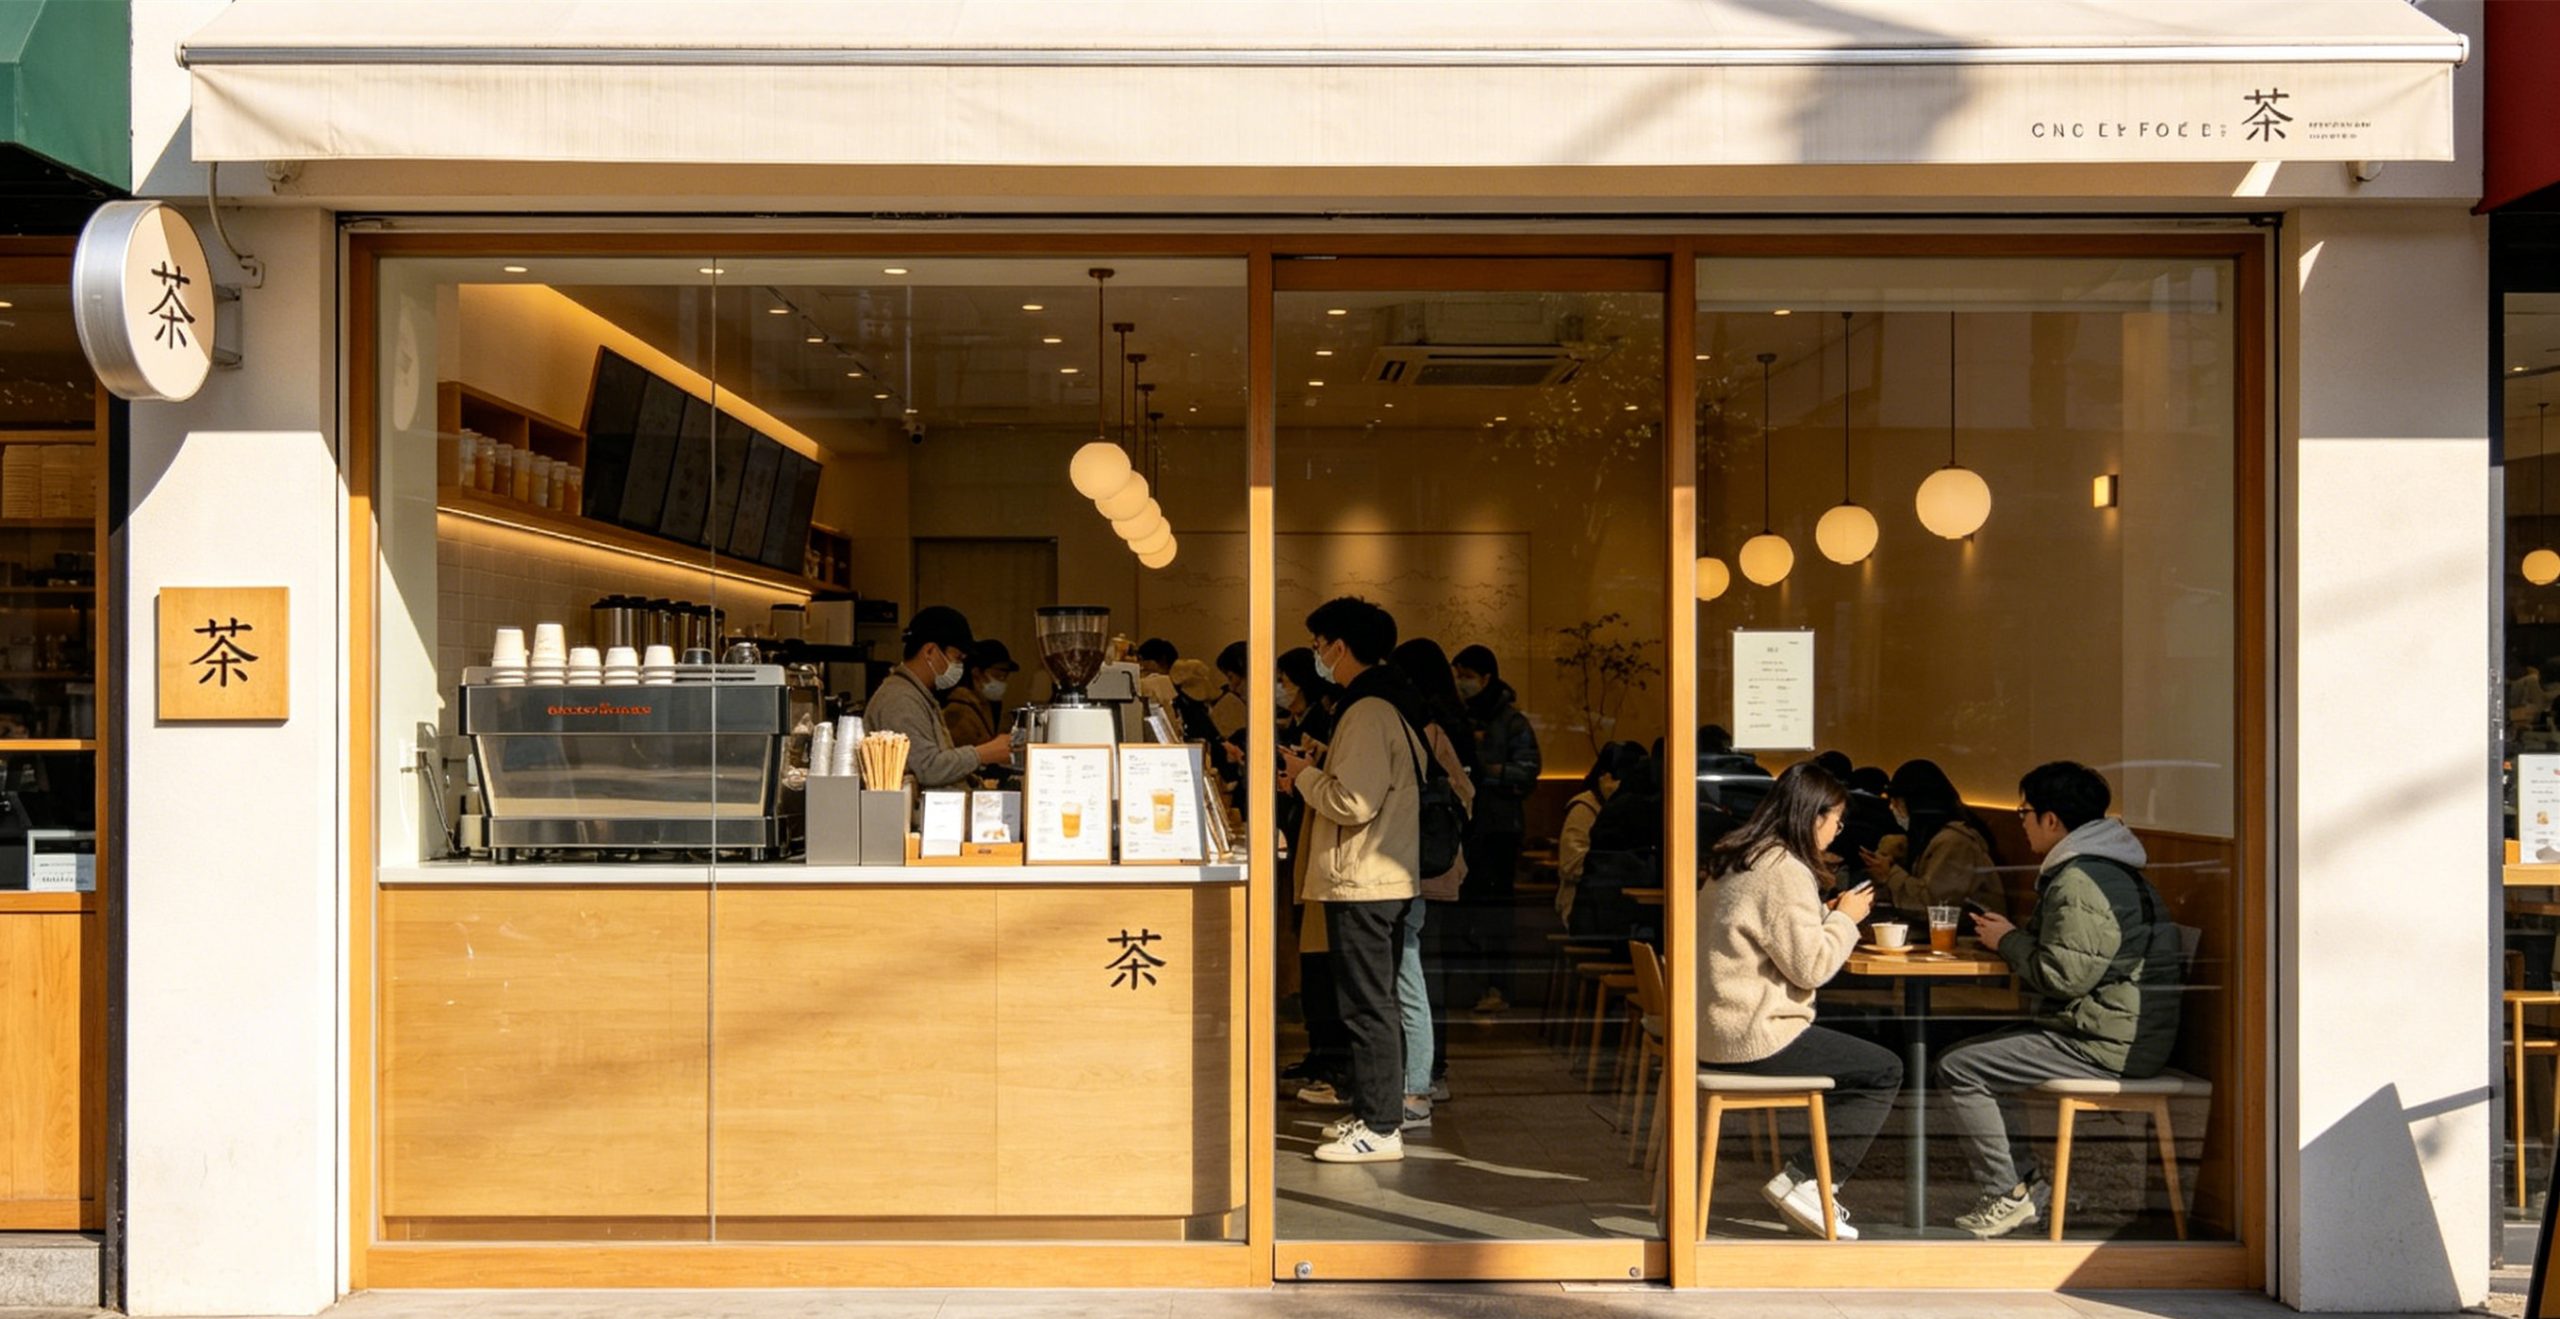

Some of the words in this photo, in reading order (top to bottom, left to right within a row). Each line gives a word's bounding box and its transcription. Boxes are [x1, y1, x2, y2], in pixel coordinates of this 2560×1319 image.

[2242, 87, 2293, 142] 茶
[148, 260, 196, 349] 茶
[189, 617, 259, 688] 茶
[1105, 928, 1166, 990] 茶
